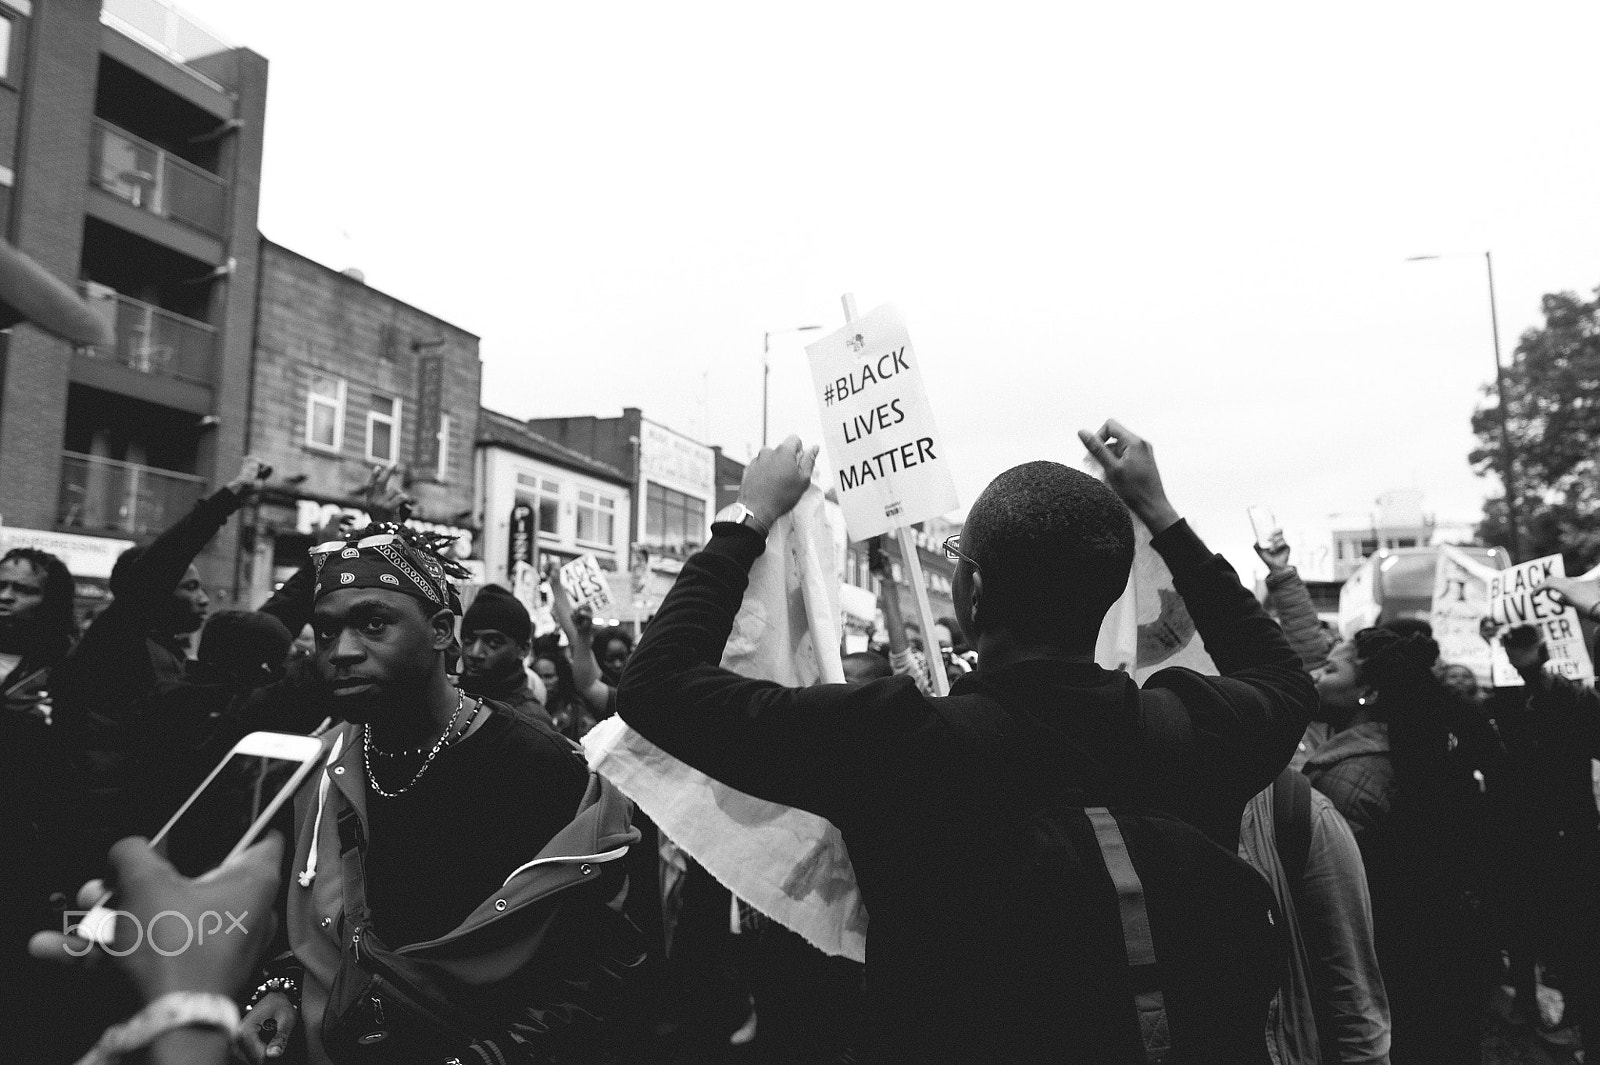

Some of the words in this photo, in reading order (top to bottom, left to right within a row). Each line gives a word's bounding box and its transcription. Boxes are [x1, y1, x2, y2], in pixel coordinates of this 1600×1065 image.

[824, 346, 910, 407] #BLACK
[843, 398, 905, 444] LIVES
[839, 437, 937, 492] MATTER
[514, 506, 529, 561] PIZZ
[1492, 561, 1552, 598] BLACK
[1492, 588, 1565, 625] LIVES
